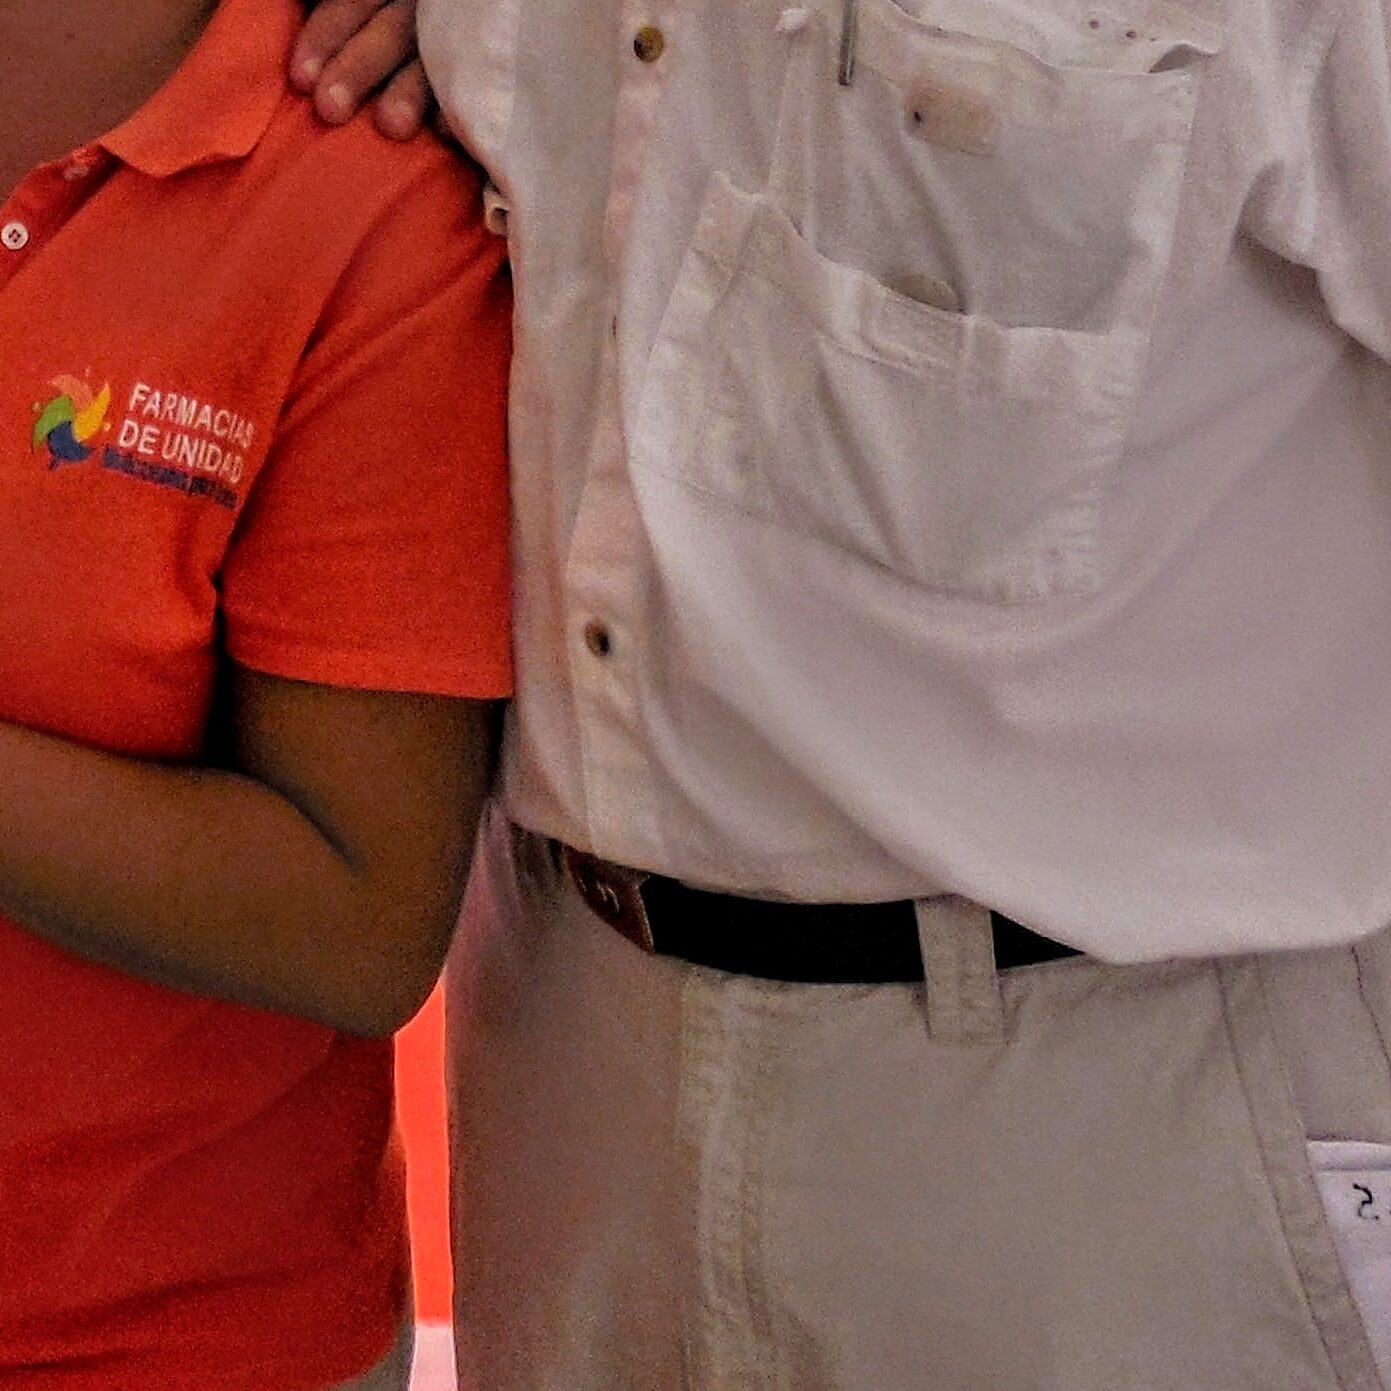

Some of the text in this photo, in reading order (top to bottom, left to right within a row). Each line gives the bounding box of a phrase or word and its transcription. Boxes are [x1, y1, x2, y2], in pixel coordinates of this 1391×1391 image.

[128, 382, 257, 449] FARMACIAS
[118, 419, 161, 456] DE
[161, 430, 245, 484] UNIDAD
